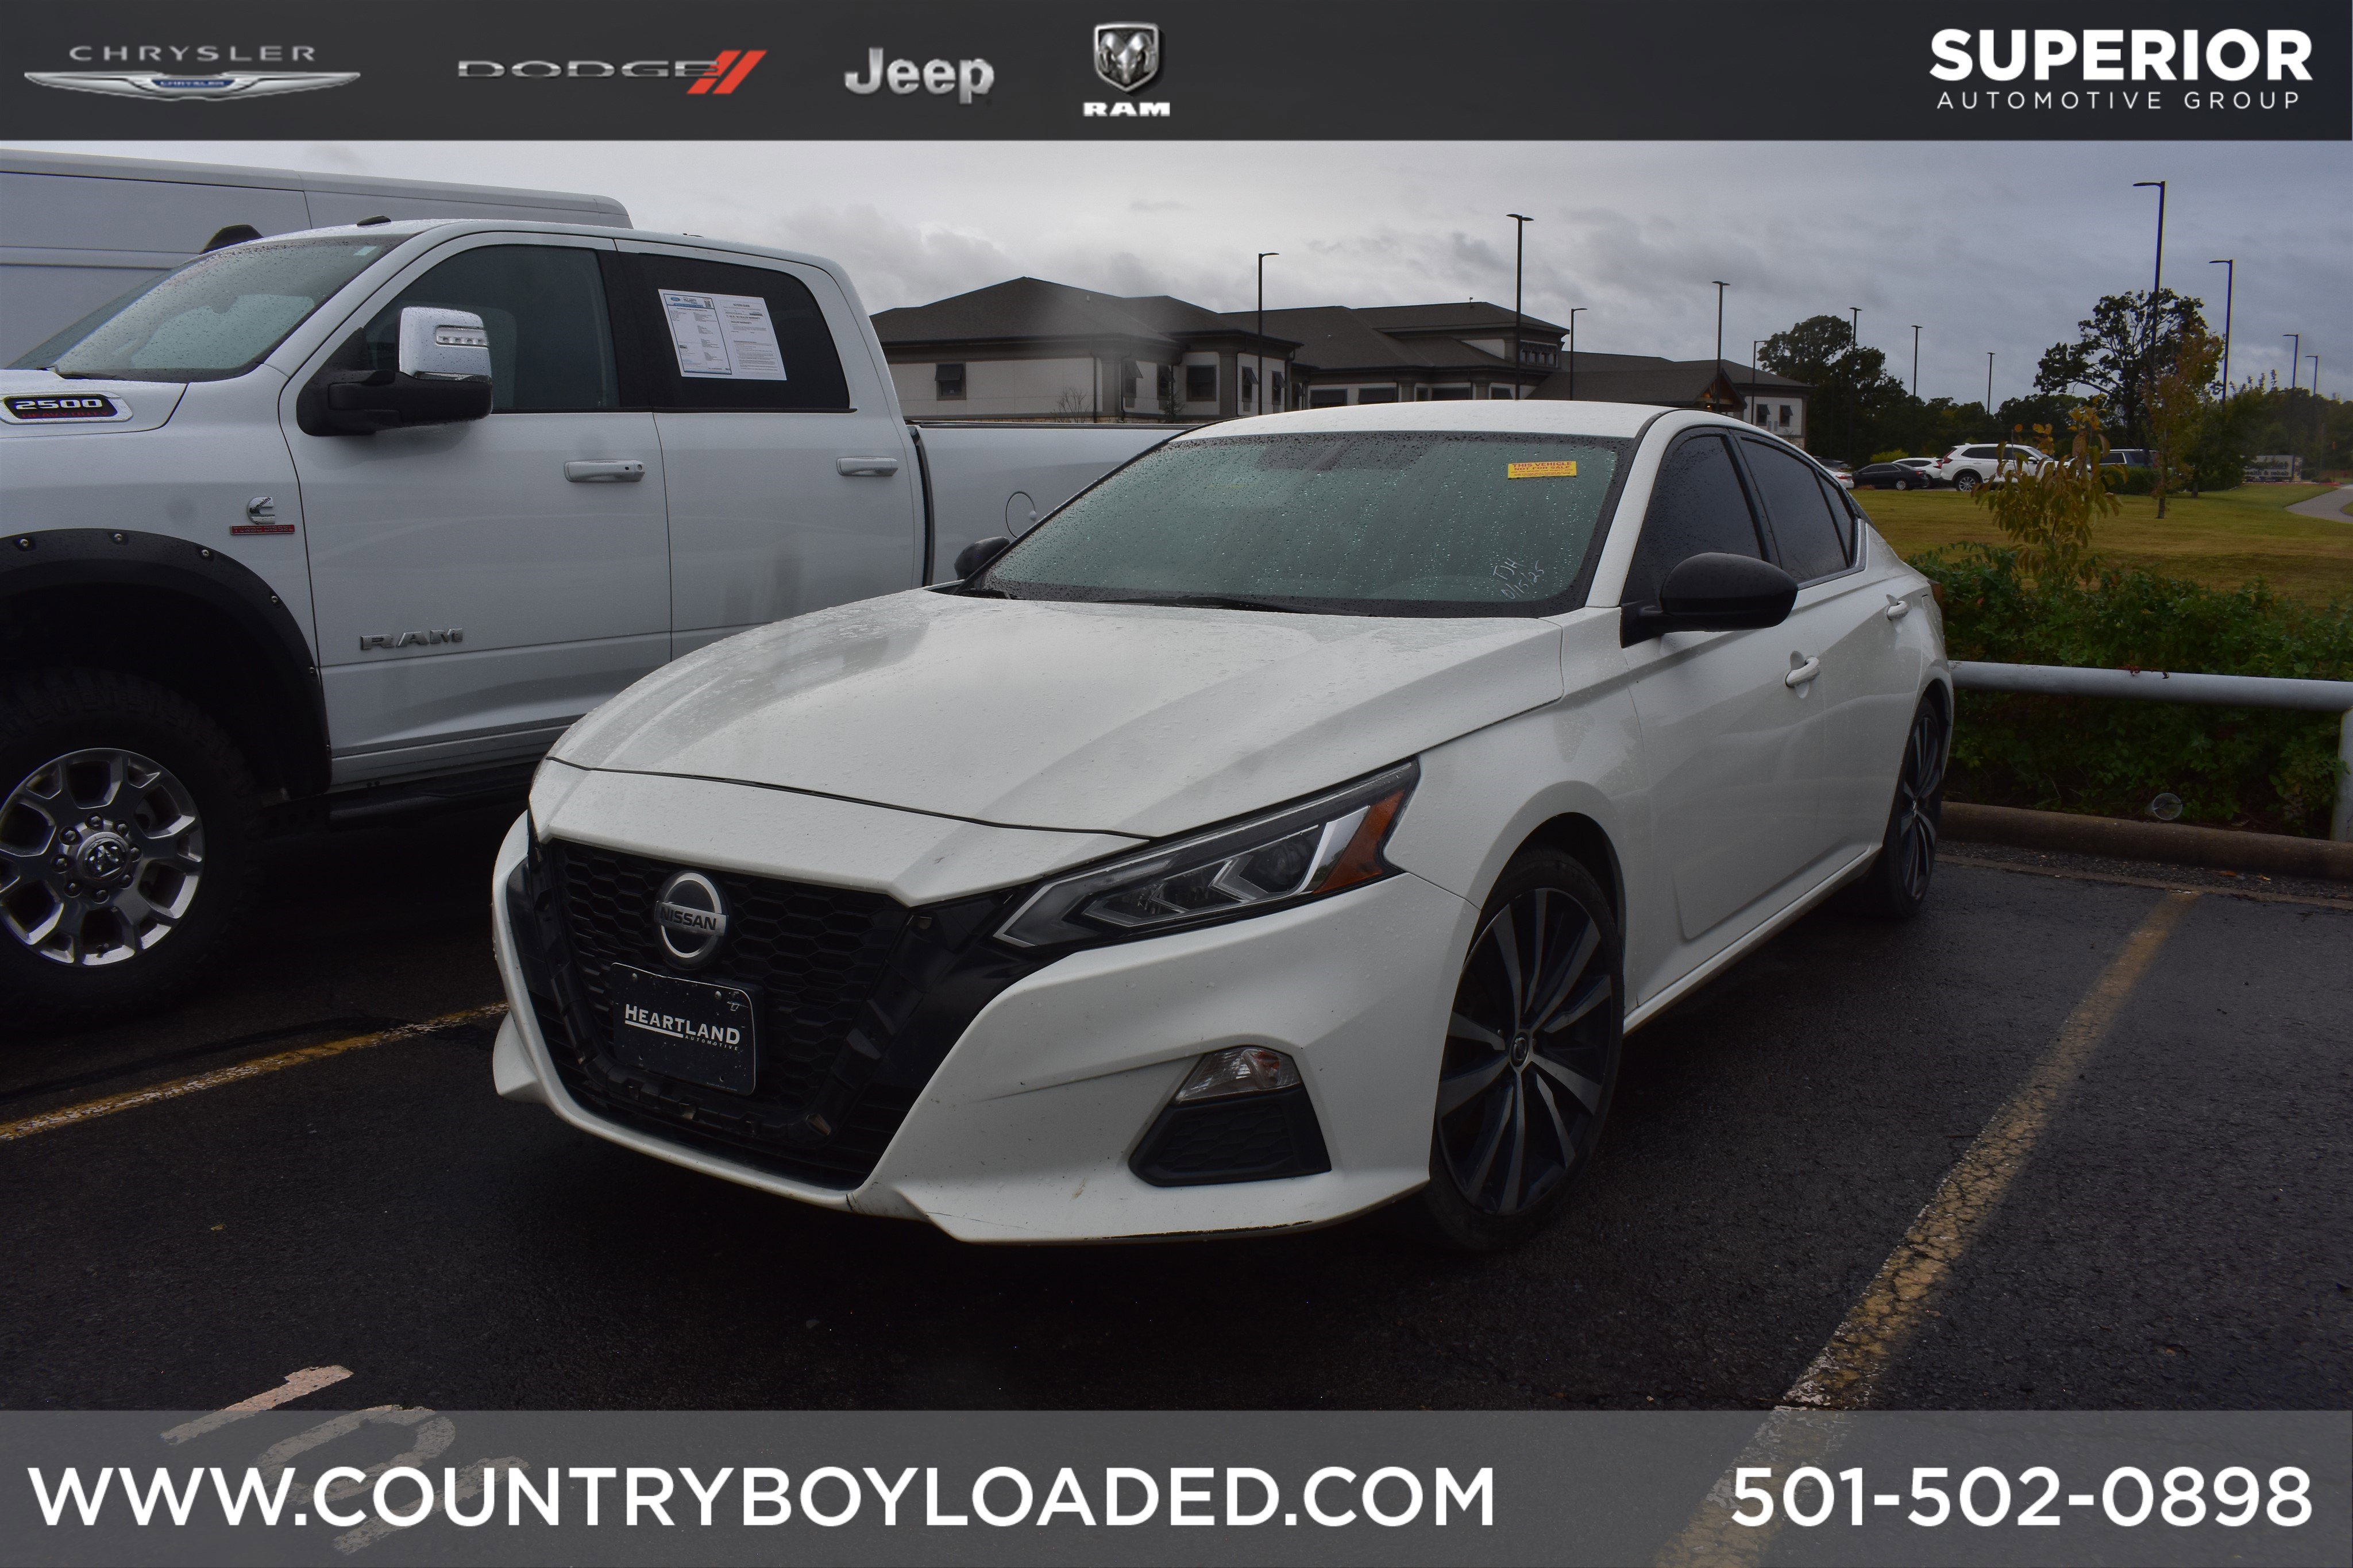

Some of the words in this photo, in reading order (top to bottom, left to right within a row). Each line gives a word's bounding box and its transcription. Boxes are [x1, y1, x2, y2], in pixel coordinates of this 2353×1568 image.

[16, 399, 103, 410] 2500
[360, 628, 463, 650] RAM
[660, 906, 717, 930] NISSAN
[625, 1003, 740, 1045] HEARTLAND
[685, 1035, 739, 1051] AUTOMOTIVE
